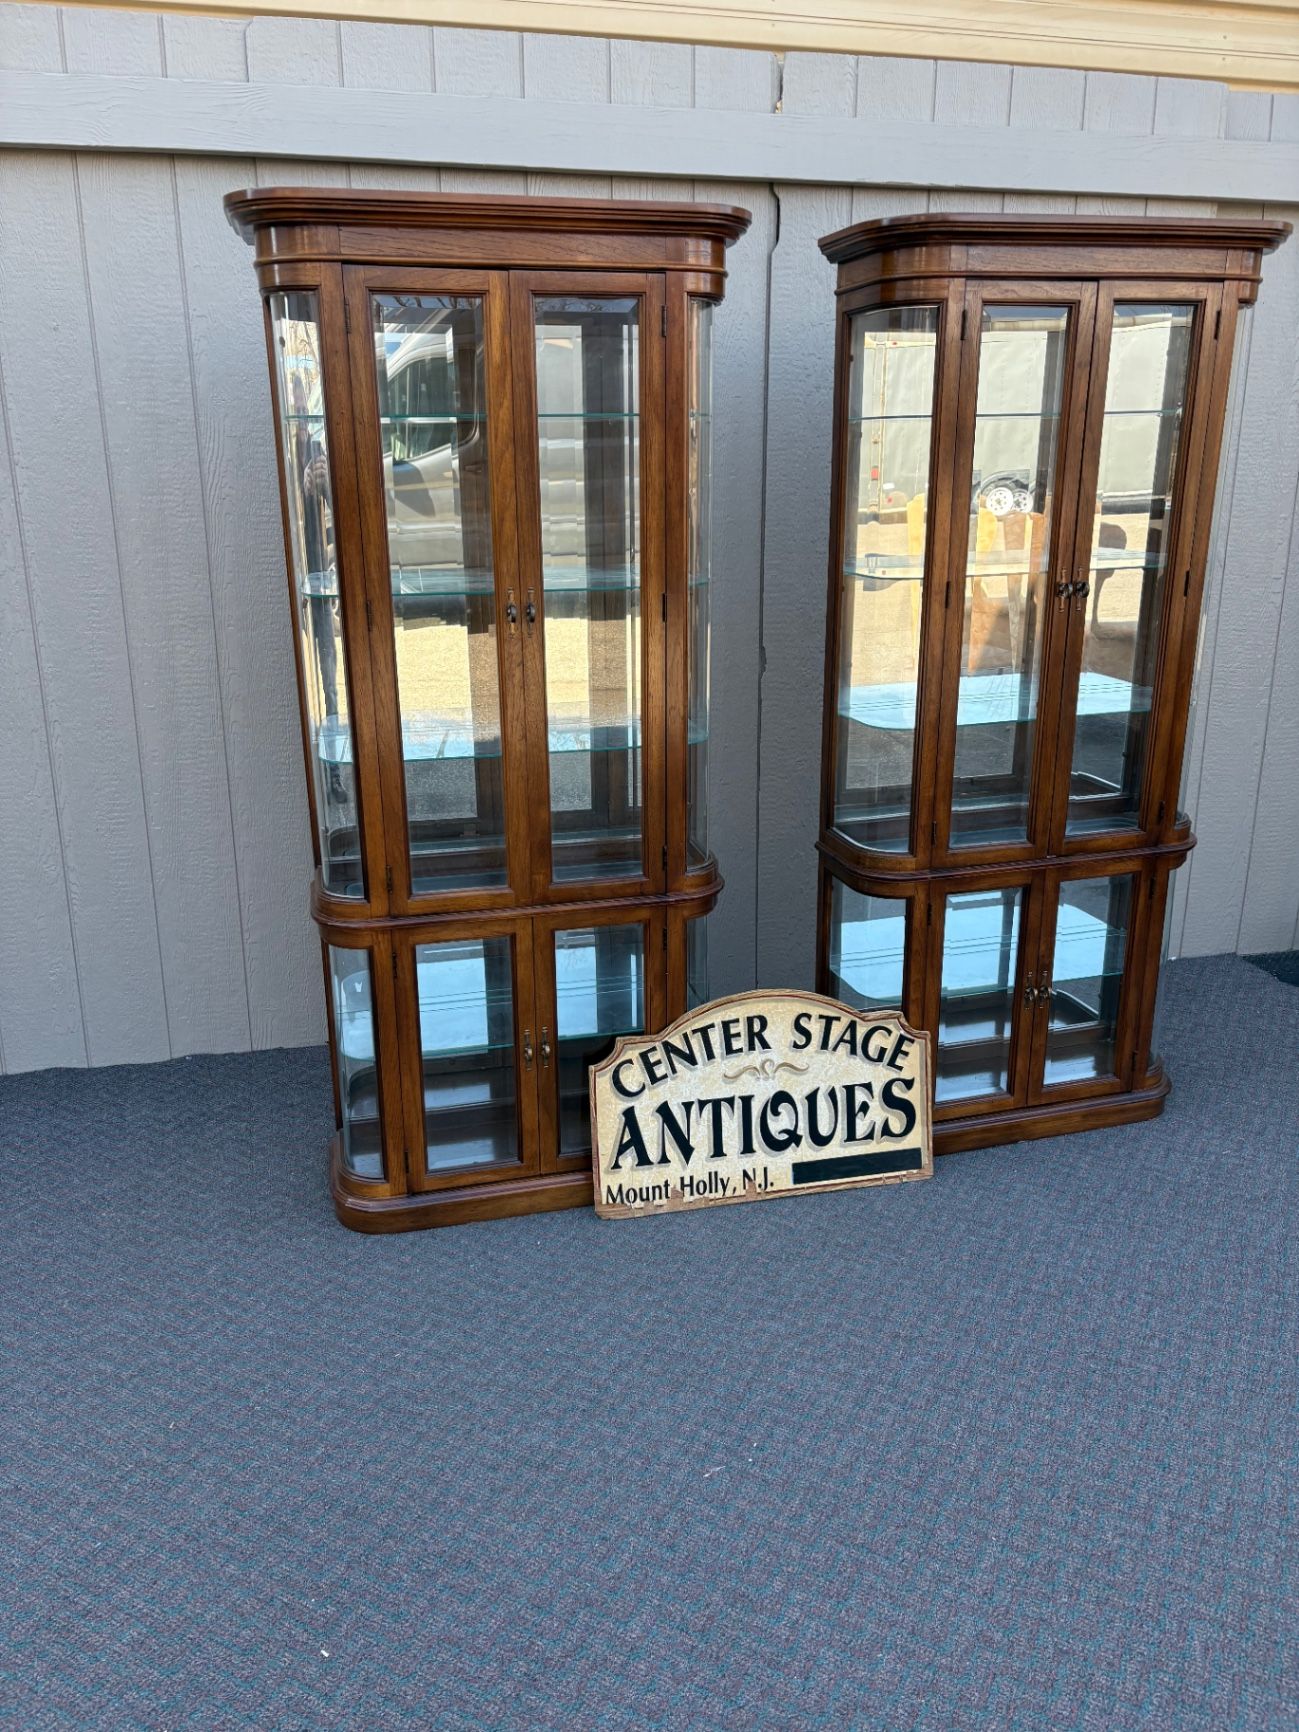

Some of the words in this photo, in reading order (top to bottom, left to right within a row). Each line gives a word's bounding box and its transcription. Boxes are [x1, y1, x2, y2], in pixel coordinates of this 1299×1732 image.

[611, 1014, 772, 1098] CENTER
[792, 1012, 915, 1072] STAGE
[610, 1076, 917, 1170] ANTIQUES
[605, 1180, 671, 1205] Mount
[679, 1171, 737, 1197] Holly,
[743, 1168, 775, 1192] N.J.
